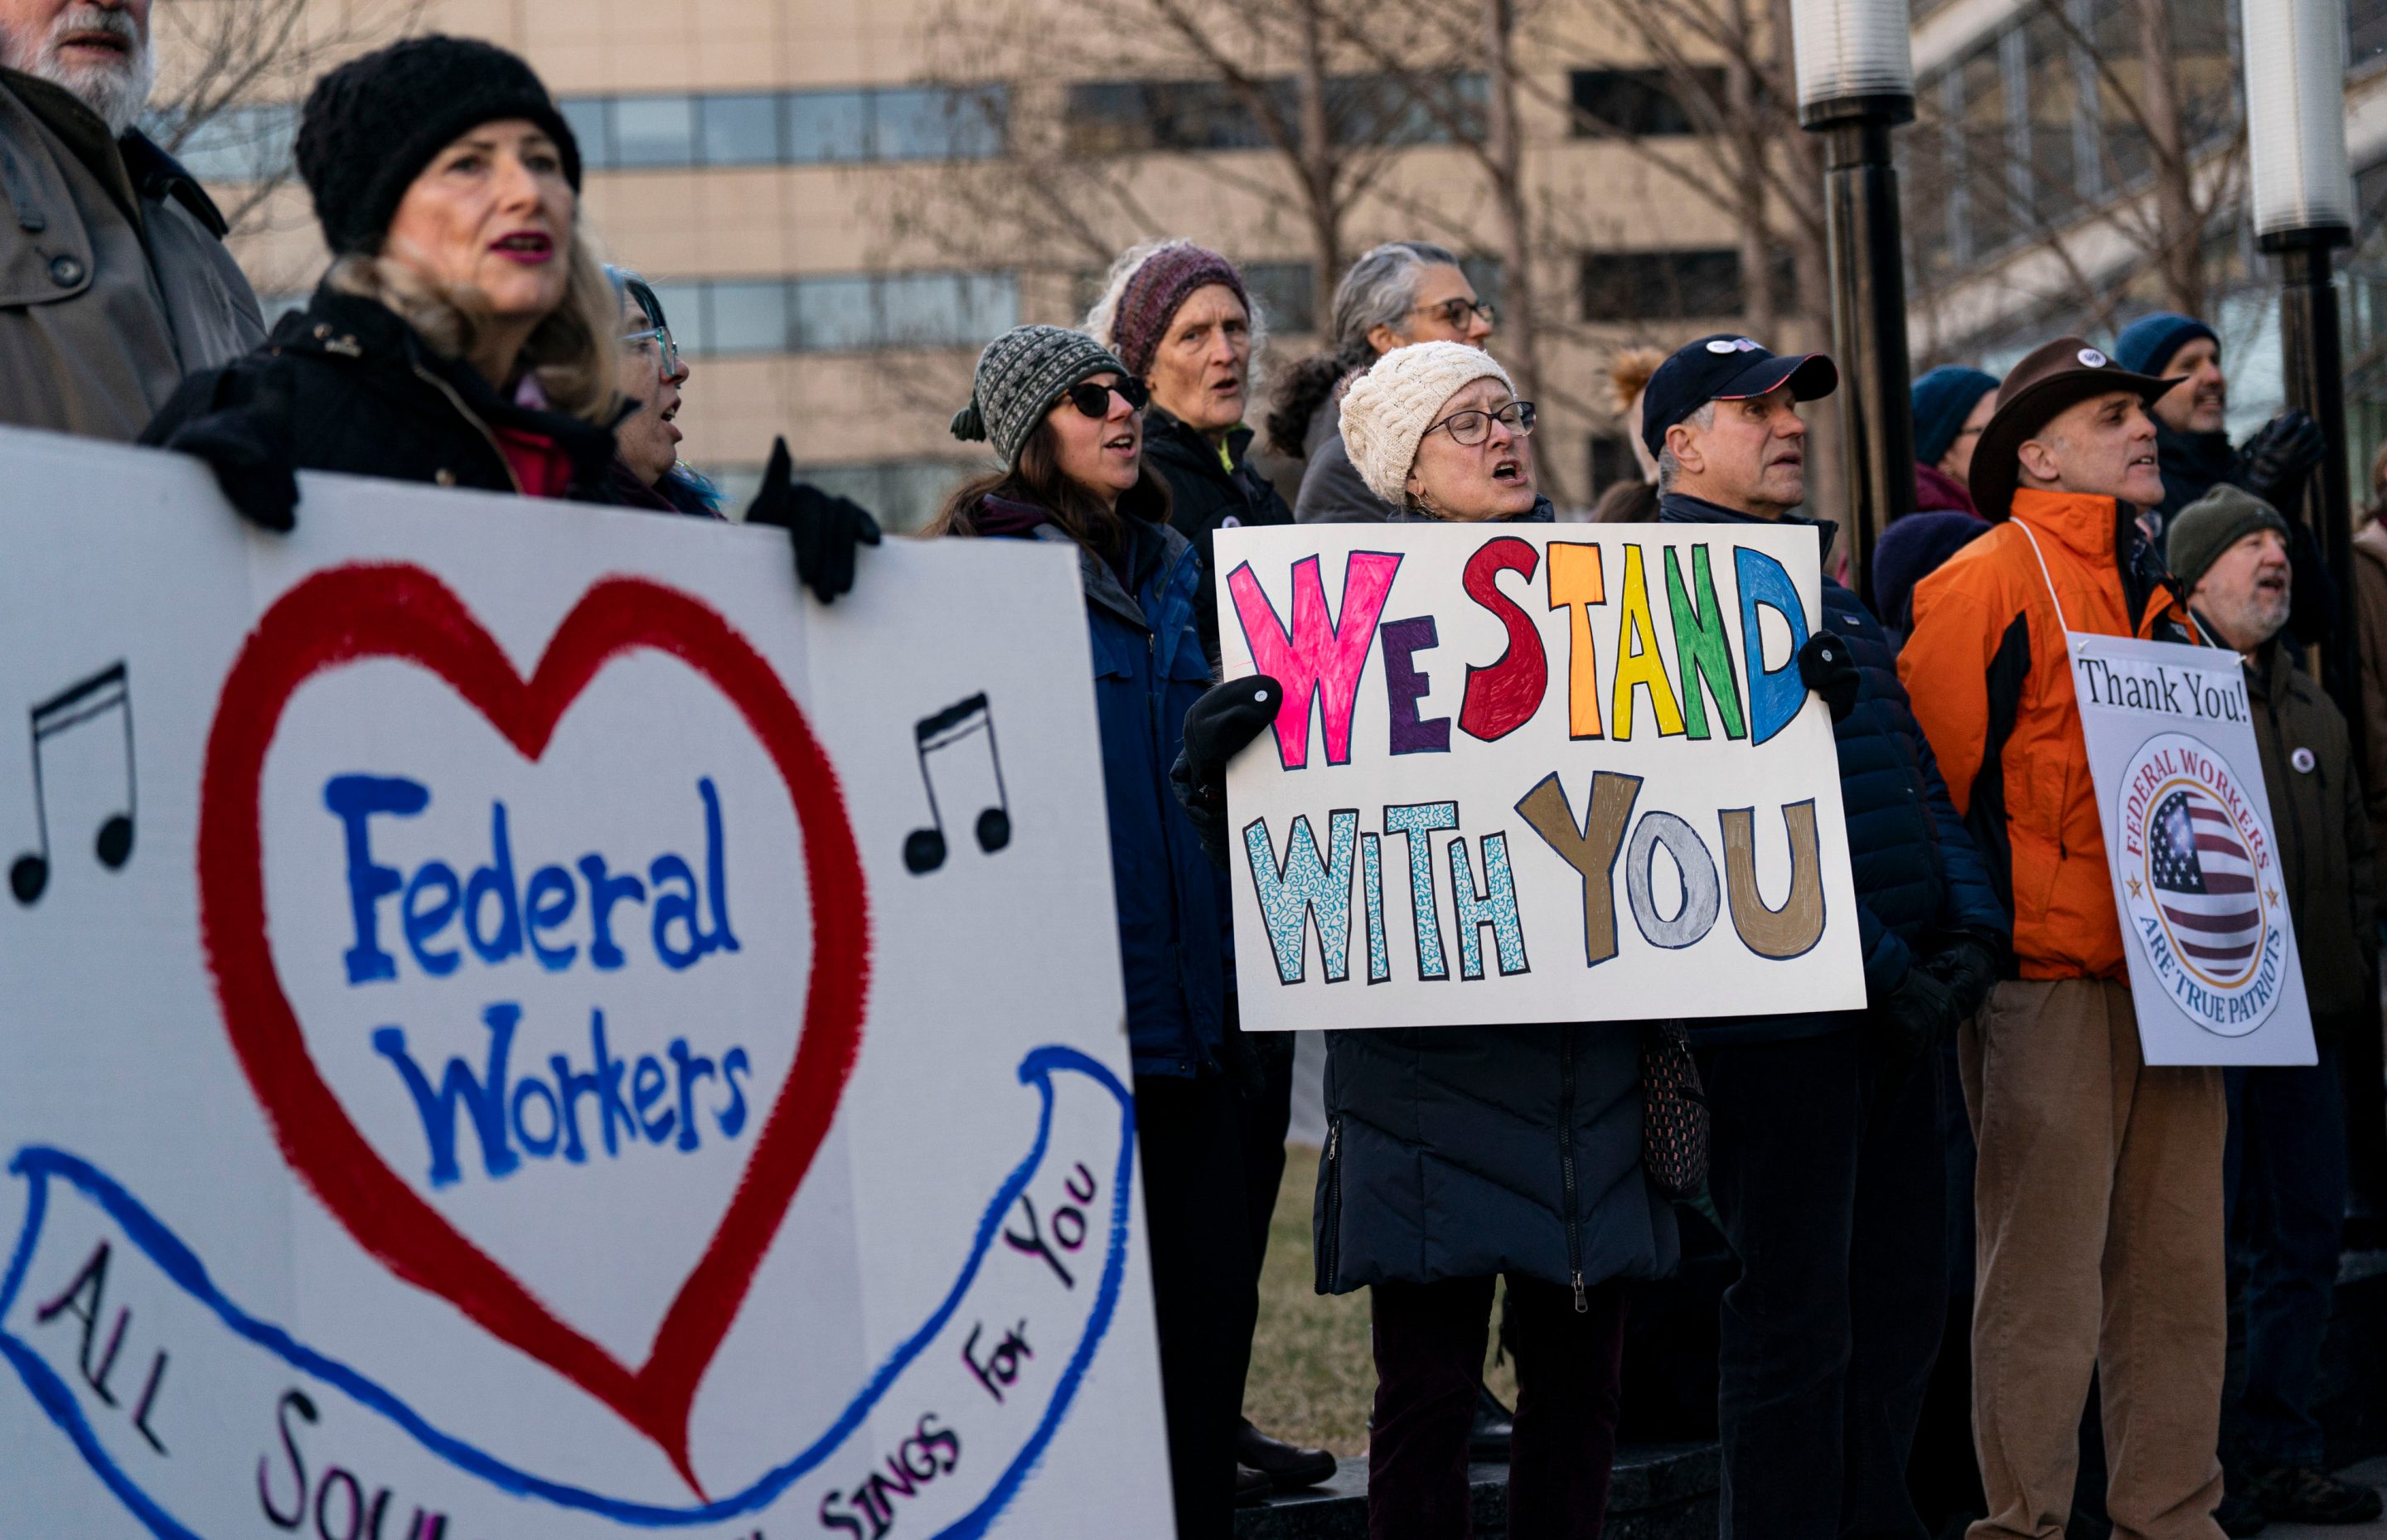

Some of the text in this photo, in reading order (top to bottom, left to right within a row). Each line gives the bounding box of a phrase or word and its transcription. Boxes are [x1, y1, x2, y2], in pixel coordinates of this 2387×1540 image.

[1227, 536, 1810, 771] WE STAND
[2078, 657, 2247, 723] Thank You!
[323, 773, 741, 985] Federal
[1242, 770, 1825, 986] WITH YOU
[2126, 747, 2269, 870] FEDERAL WORKERS
[2139, 915, 2280, 1024] ARE TRUE PATRIOTS
[371, 1003, 751, 1190] Workers
[36, 1239, 169, 1456] ALL
[818, 1412, 961, 1540] SINGS
